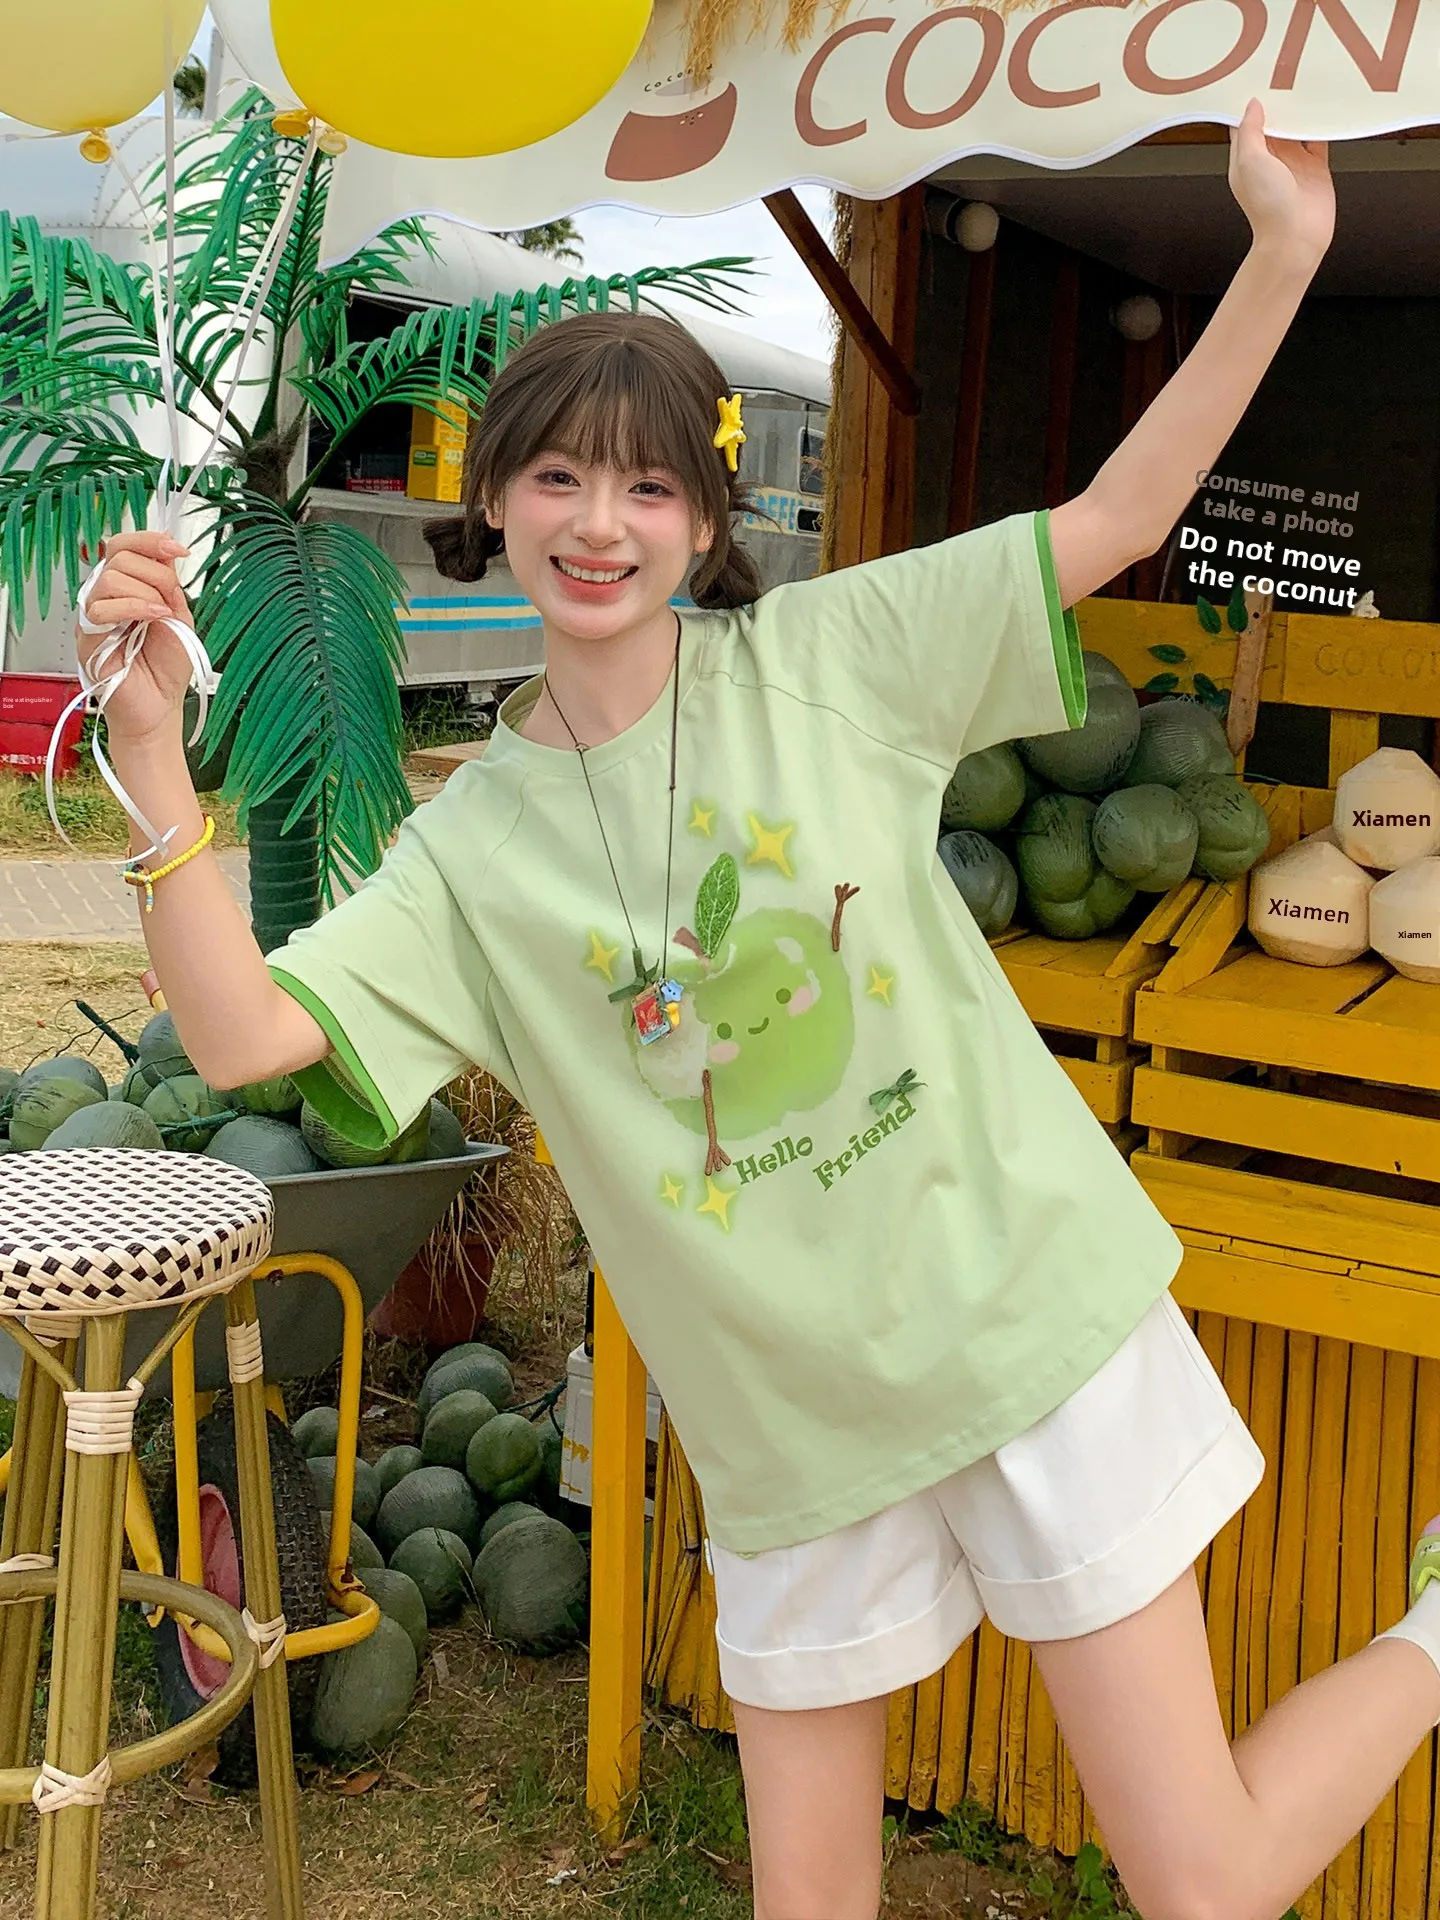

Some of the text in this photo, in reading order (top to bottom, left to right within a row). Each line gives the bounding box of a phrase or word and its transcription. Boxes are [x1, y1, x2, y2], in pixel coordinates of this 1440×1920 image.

[794, 0, 1421, 147] COCON
[14, 696, 53, 704] extinguisher
[1352, 809, 1431, 827] Xiamen
[1267, 898, 1350, 924] Xiamen
[1397, 930, 1432, 939] Xiamen
[812, 1092, 916, 1192] Friend
[733, 1135, 813, 1185] Hello
